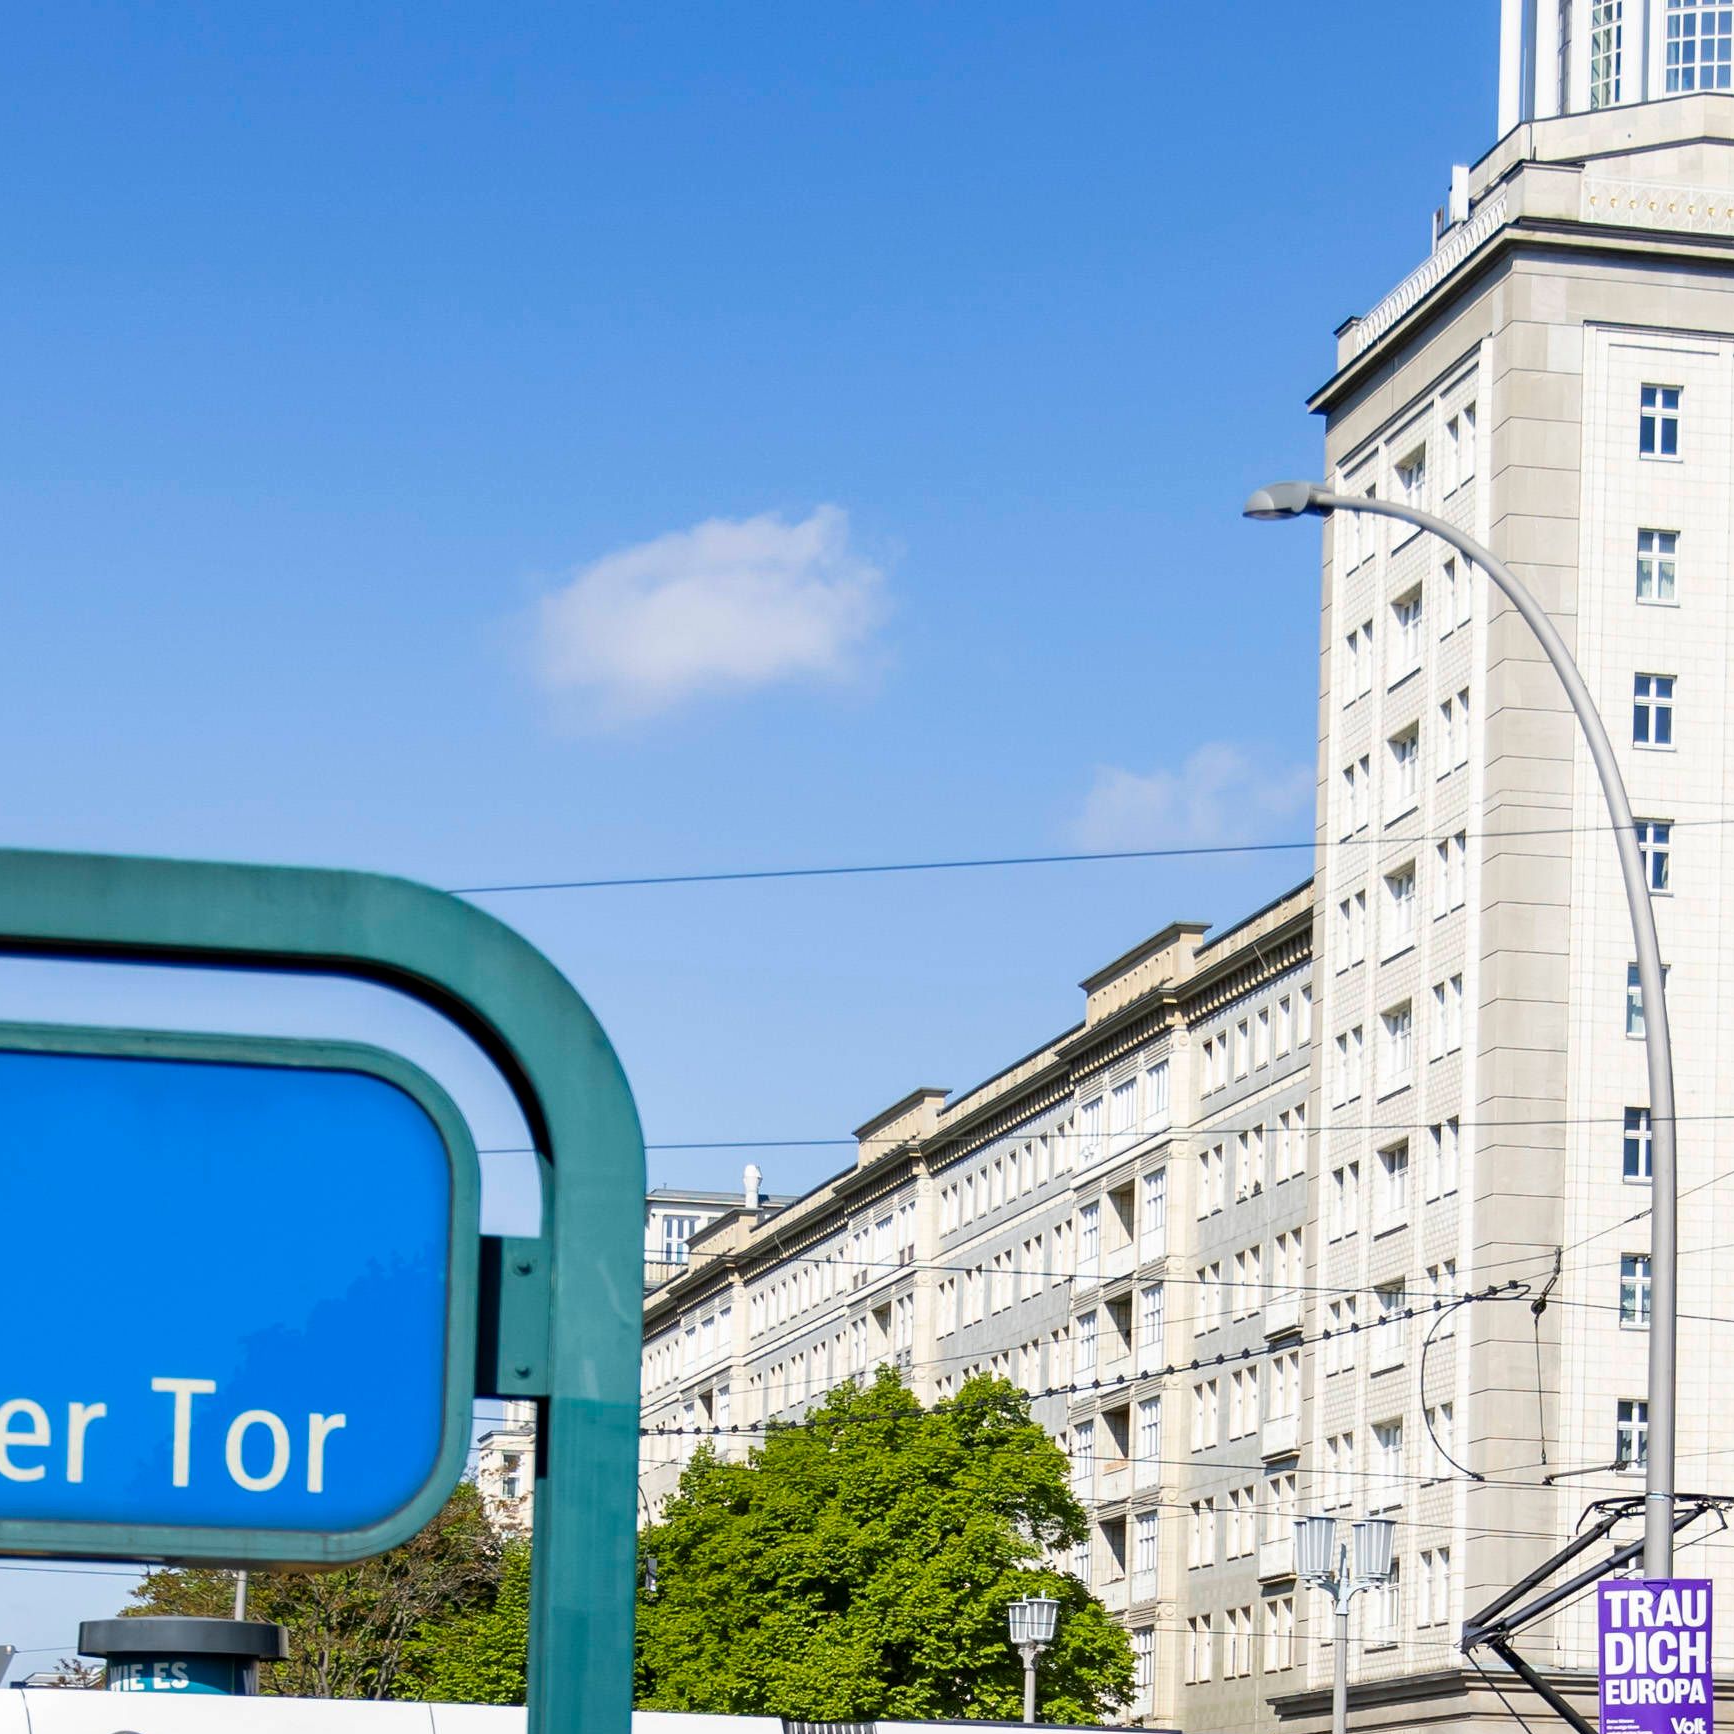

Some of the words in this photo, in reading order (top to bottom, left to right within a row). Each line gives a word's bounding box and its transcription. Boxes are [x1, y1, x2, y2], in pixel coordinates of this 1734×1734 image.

[150, 1375, 348, 1495] Tor
[1604, 1588, 1708, 1629] TRAU
[1605, 1630, 1708, 1675] DICH
[152, 1662, 190, 1691] ES
[1605, 1677, 1707, 1706] EUROPA
